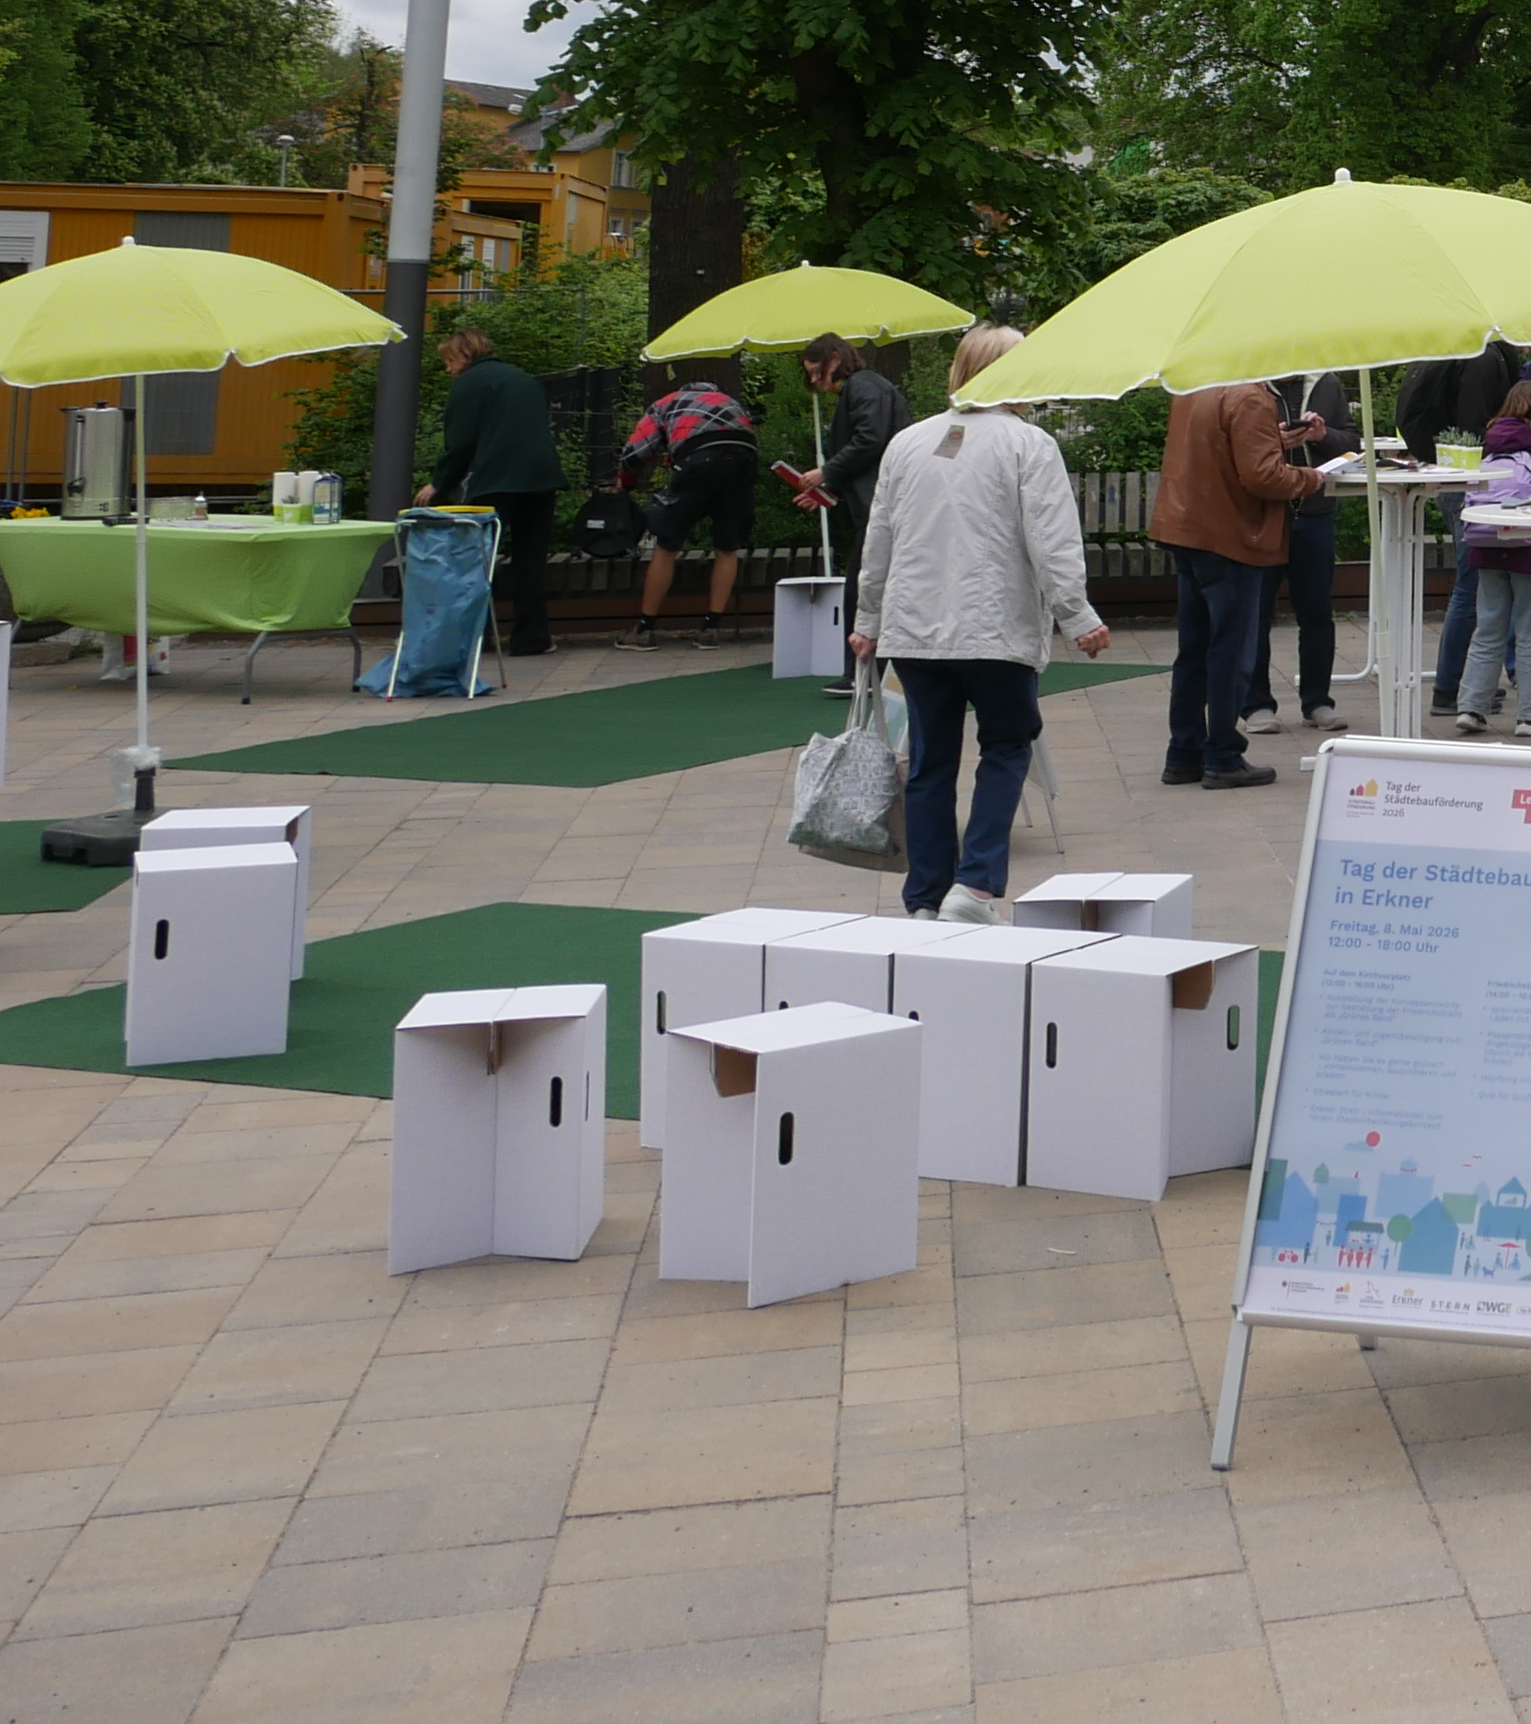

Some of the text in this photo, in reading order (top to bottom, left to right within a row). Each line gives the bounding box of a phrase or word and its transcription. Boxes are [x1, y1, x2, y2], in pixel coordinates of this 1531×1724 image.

[1386, 781, 1421, 794] Tag der
[1384, 795, 1484, 812] Städtebauförderung
[1382, 808, 1405, 817] 2026
[1340, 859, 1376, 882] Tag
[1383, 861, 1418, 881] der
[1334, 886, 1433, 910] in Erkner
[1330, 919, 1460, 938] Freitag, 8. Mai 2026
[1328, 936, 1362, 949] 12:00
[1377, 939, 1411, 952] 18:00
[1416, 941, 1440, 954] Uhr
[1391, 1294, 1424, 1306] Erkner
[1430, 1300, 1470, 1311] STERN
